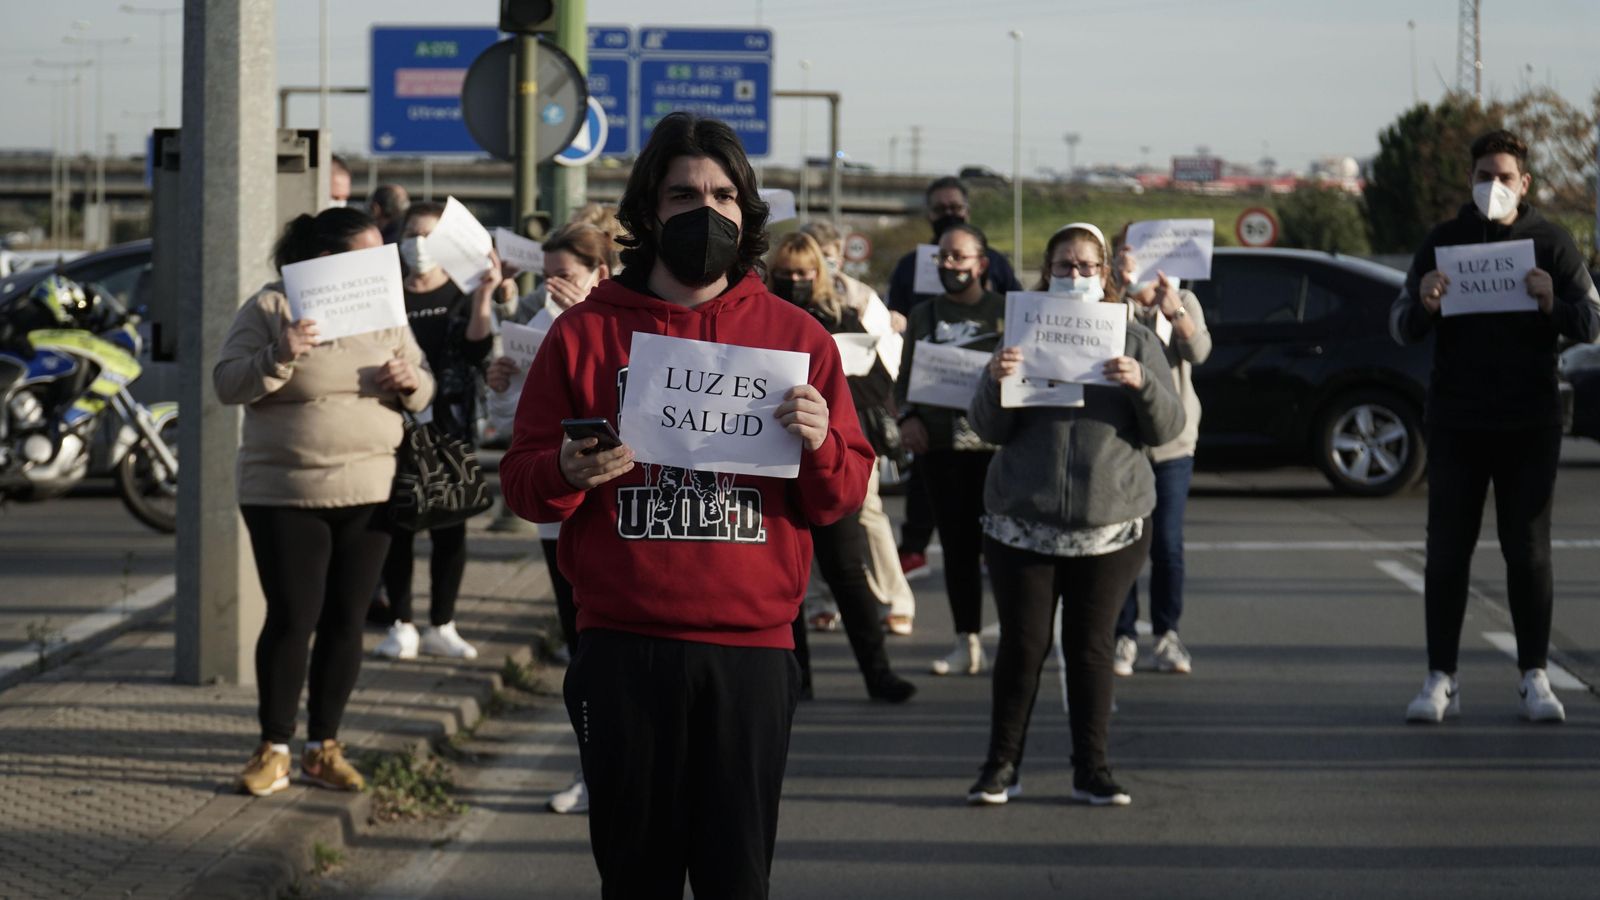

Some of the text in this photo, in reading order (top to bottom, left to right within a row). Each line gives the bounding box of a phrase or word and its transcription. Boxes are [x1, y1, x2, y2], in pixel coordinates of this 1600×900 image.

[1458, 257, 1515, 275] LUZ ES
[1460, 278, 1516, 294] SALUD
[1024, 312, 1113, 331] LA LUZ ES UN
[664, 367, 768, 400] LUZ ES
[661, 405, 764, 437] SALUD
